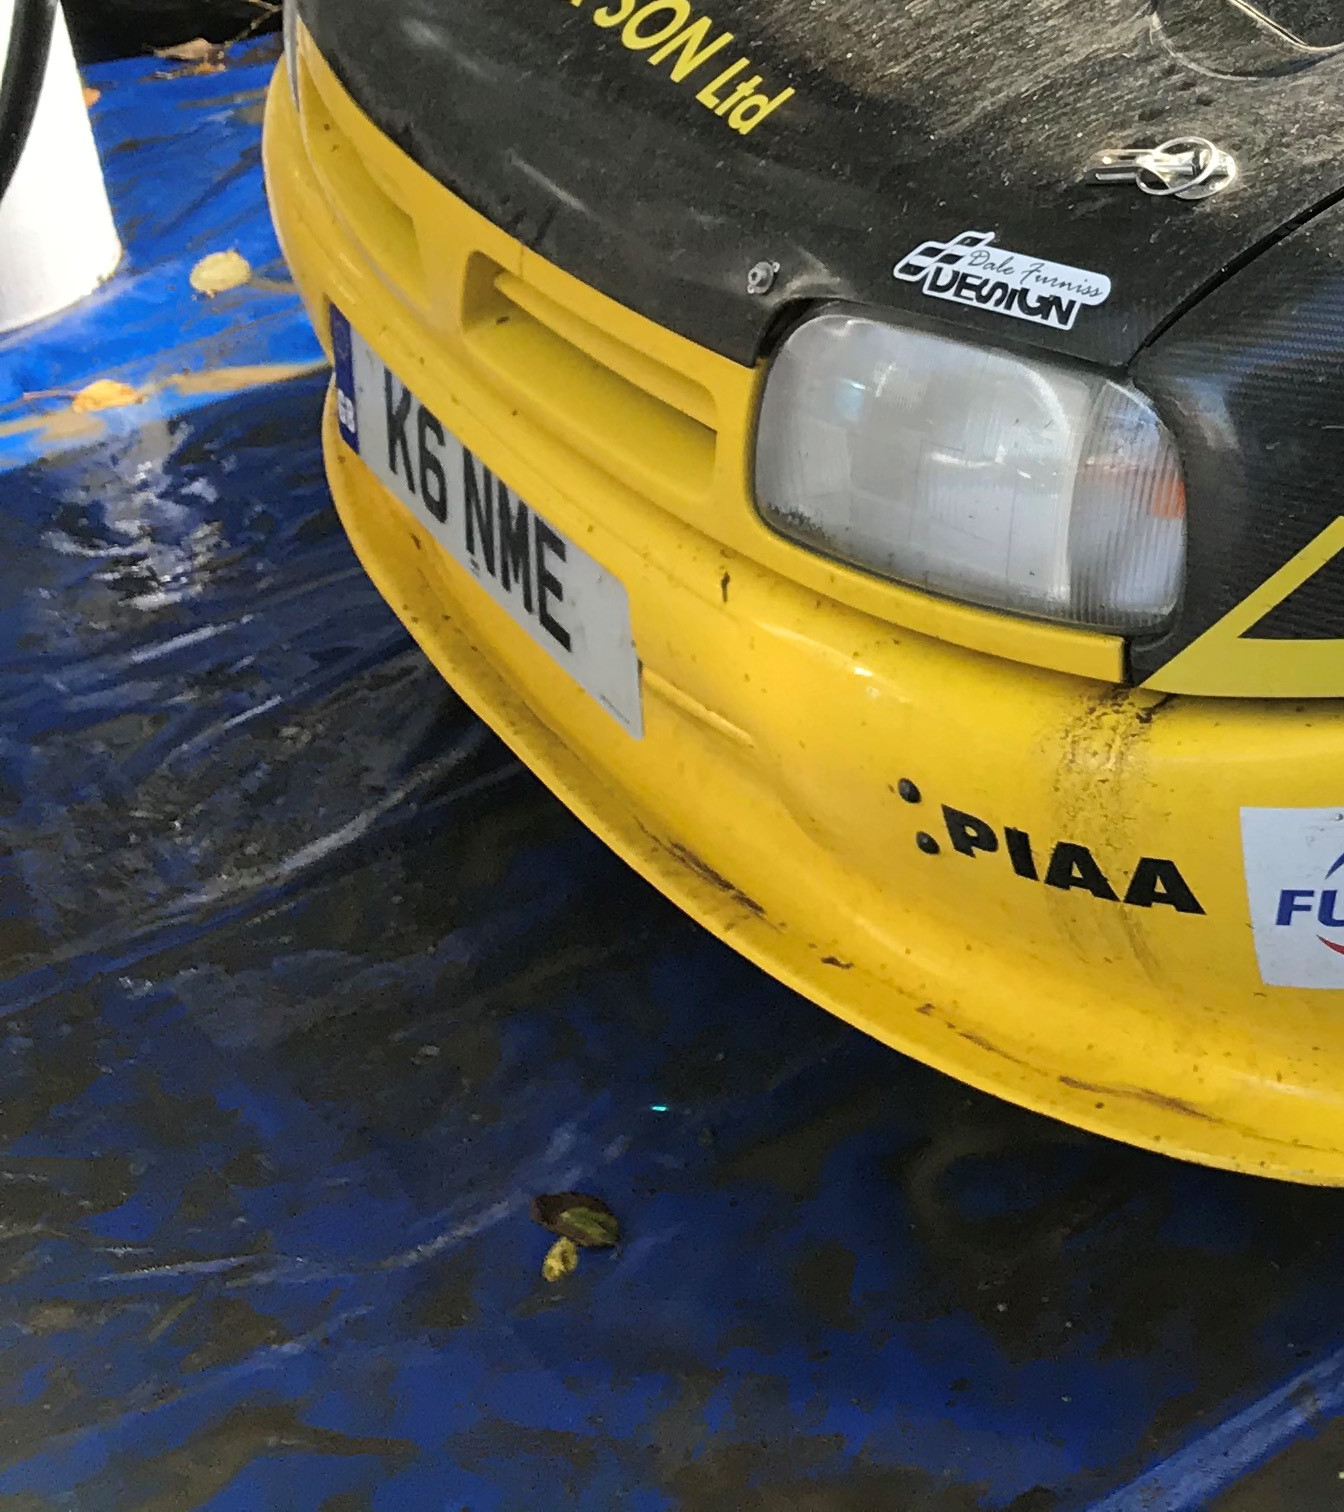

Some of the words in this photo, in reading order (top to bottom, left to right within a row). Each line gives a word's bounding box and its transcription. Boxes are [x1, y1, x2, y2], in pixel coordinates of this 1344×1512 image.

[695, 56, 796, 136] Ltd
[927, 266, 1077, 327] DESIGN
[967, 249, 1017, 276] Dale
[1019, 261, 1104, 298] Furniss
[383, 368, 448, 524] K6
[462, 445, 573, 654] NME
[940, 803, 1208, 916] PIAA
